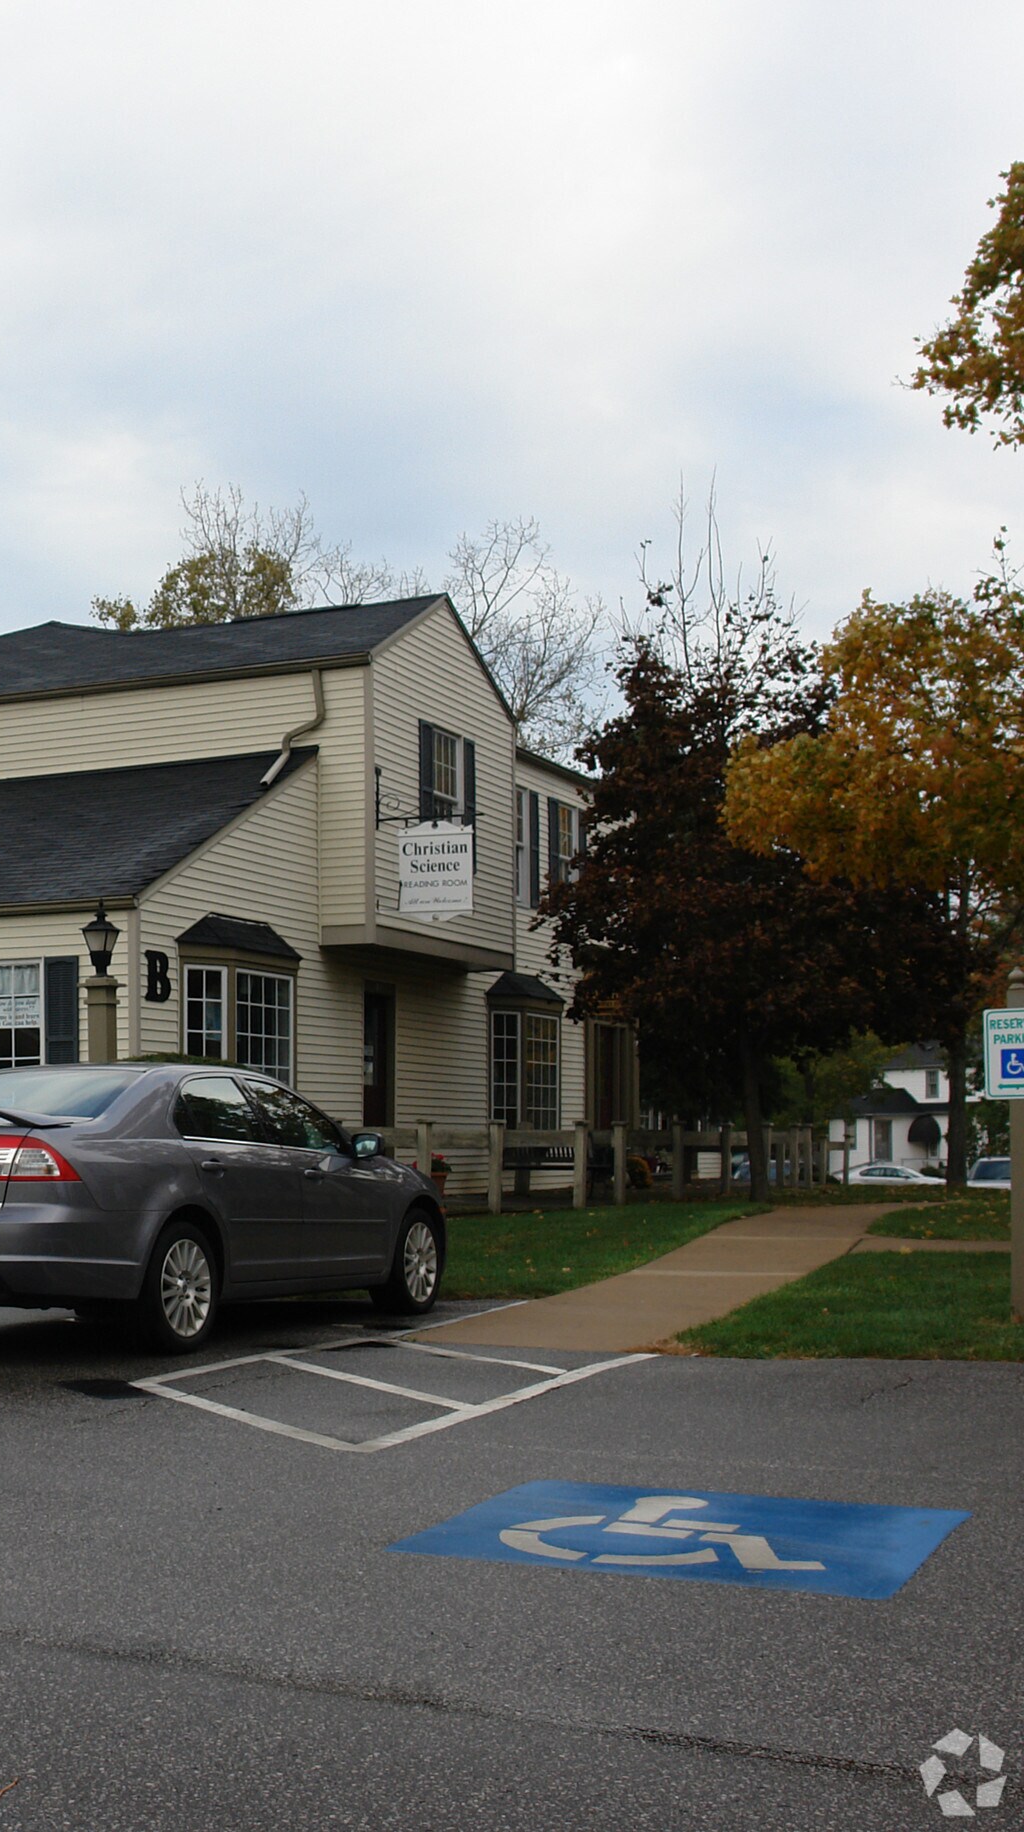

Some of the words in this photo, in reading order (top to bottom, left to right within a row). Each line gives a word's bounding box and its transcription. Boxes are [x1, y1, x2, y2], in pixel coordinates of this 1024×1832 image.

[402, 841, 468, 856] Christian
[410, 859, 460, 874] Science
[403, 880, 439, 888] READING
[442, 879, 468, 887] ROOM
[144, 950, 172, 1003] B
[989, 1018, 1024, 1029] RESER
